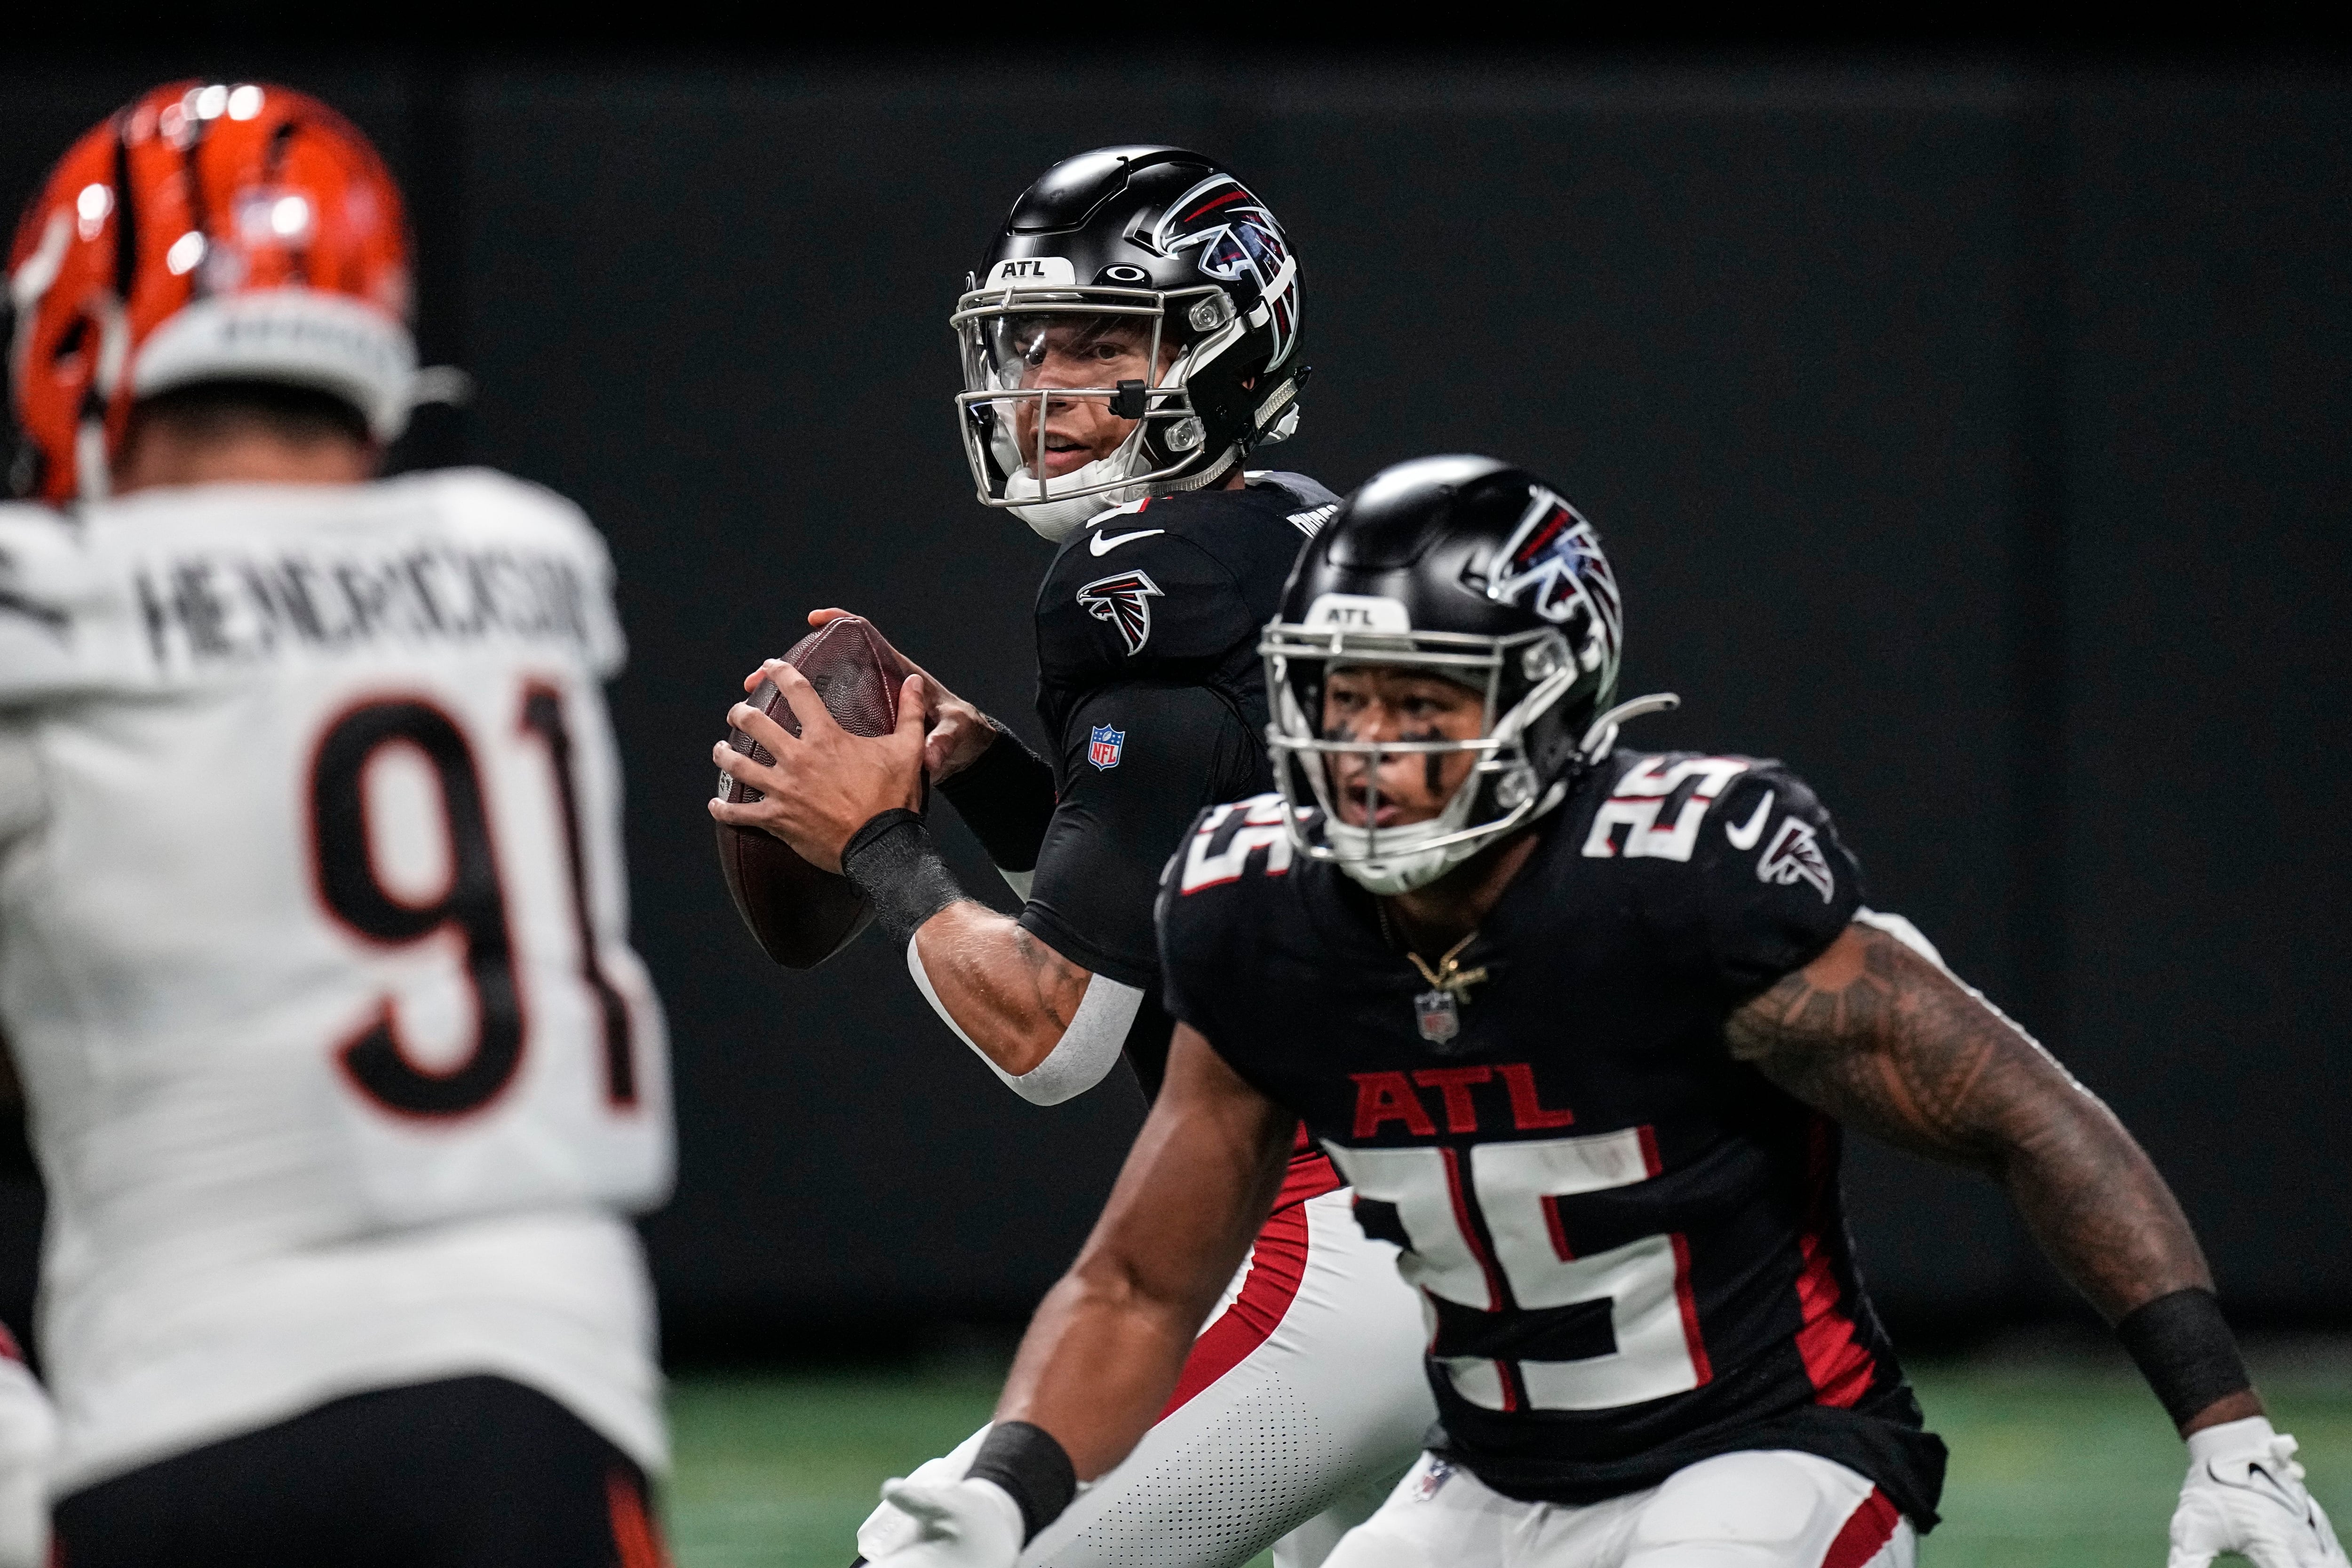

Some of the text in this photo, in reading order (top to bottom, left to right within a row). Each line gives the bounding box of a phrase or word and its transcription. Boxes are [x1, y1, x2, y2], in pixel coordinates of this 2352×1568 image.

[1001, 261, 1045, 278] ATL
[1326, 608, 1375, 626] ATL
[1091, 742, 1116, 765] NFL
[1581, 755, 1750, 862] 25
[300, 682, 640, 1122] 91
[1348, 1062, 1574, 1138] ATL
[1319, 1125, 1714, 1412] 25
